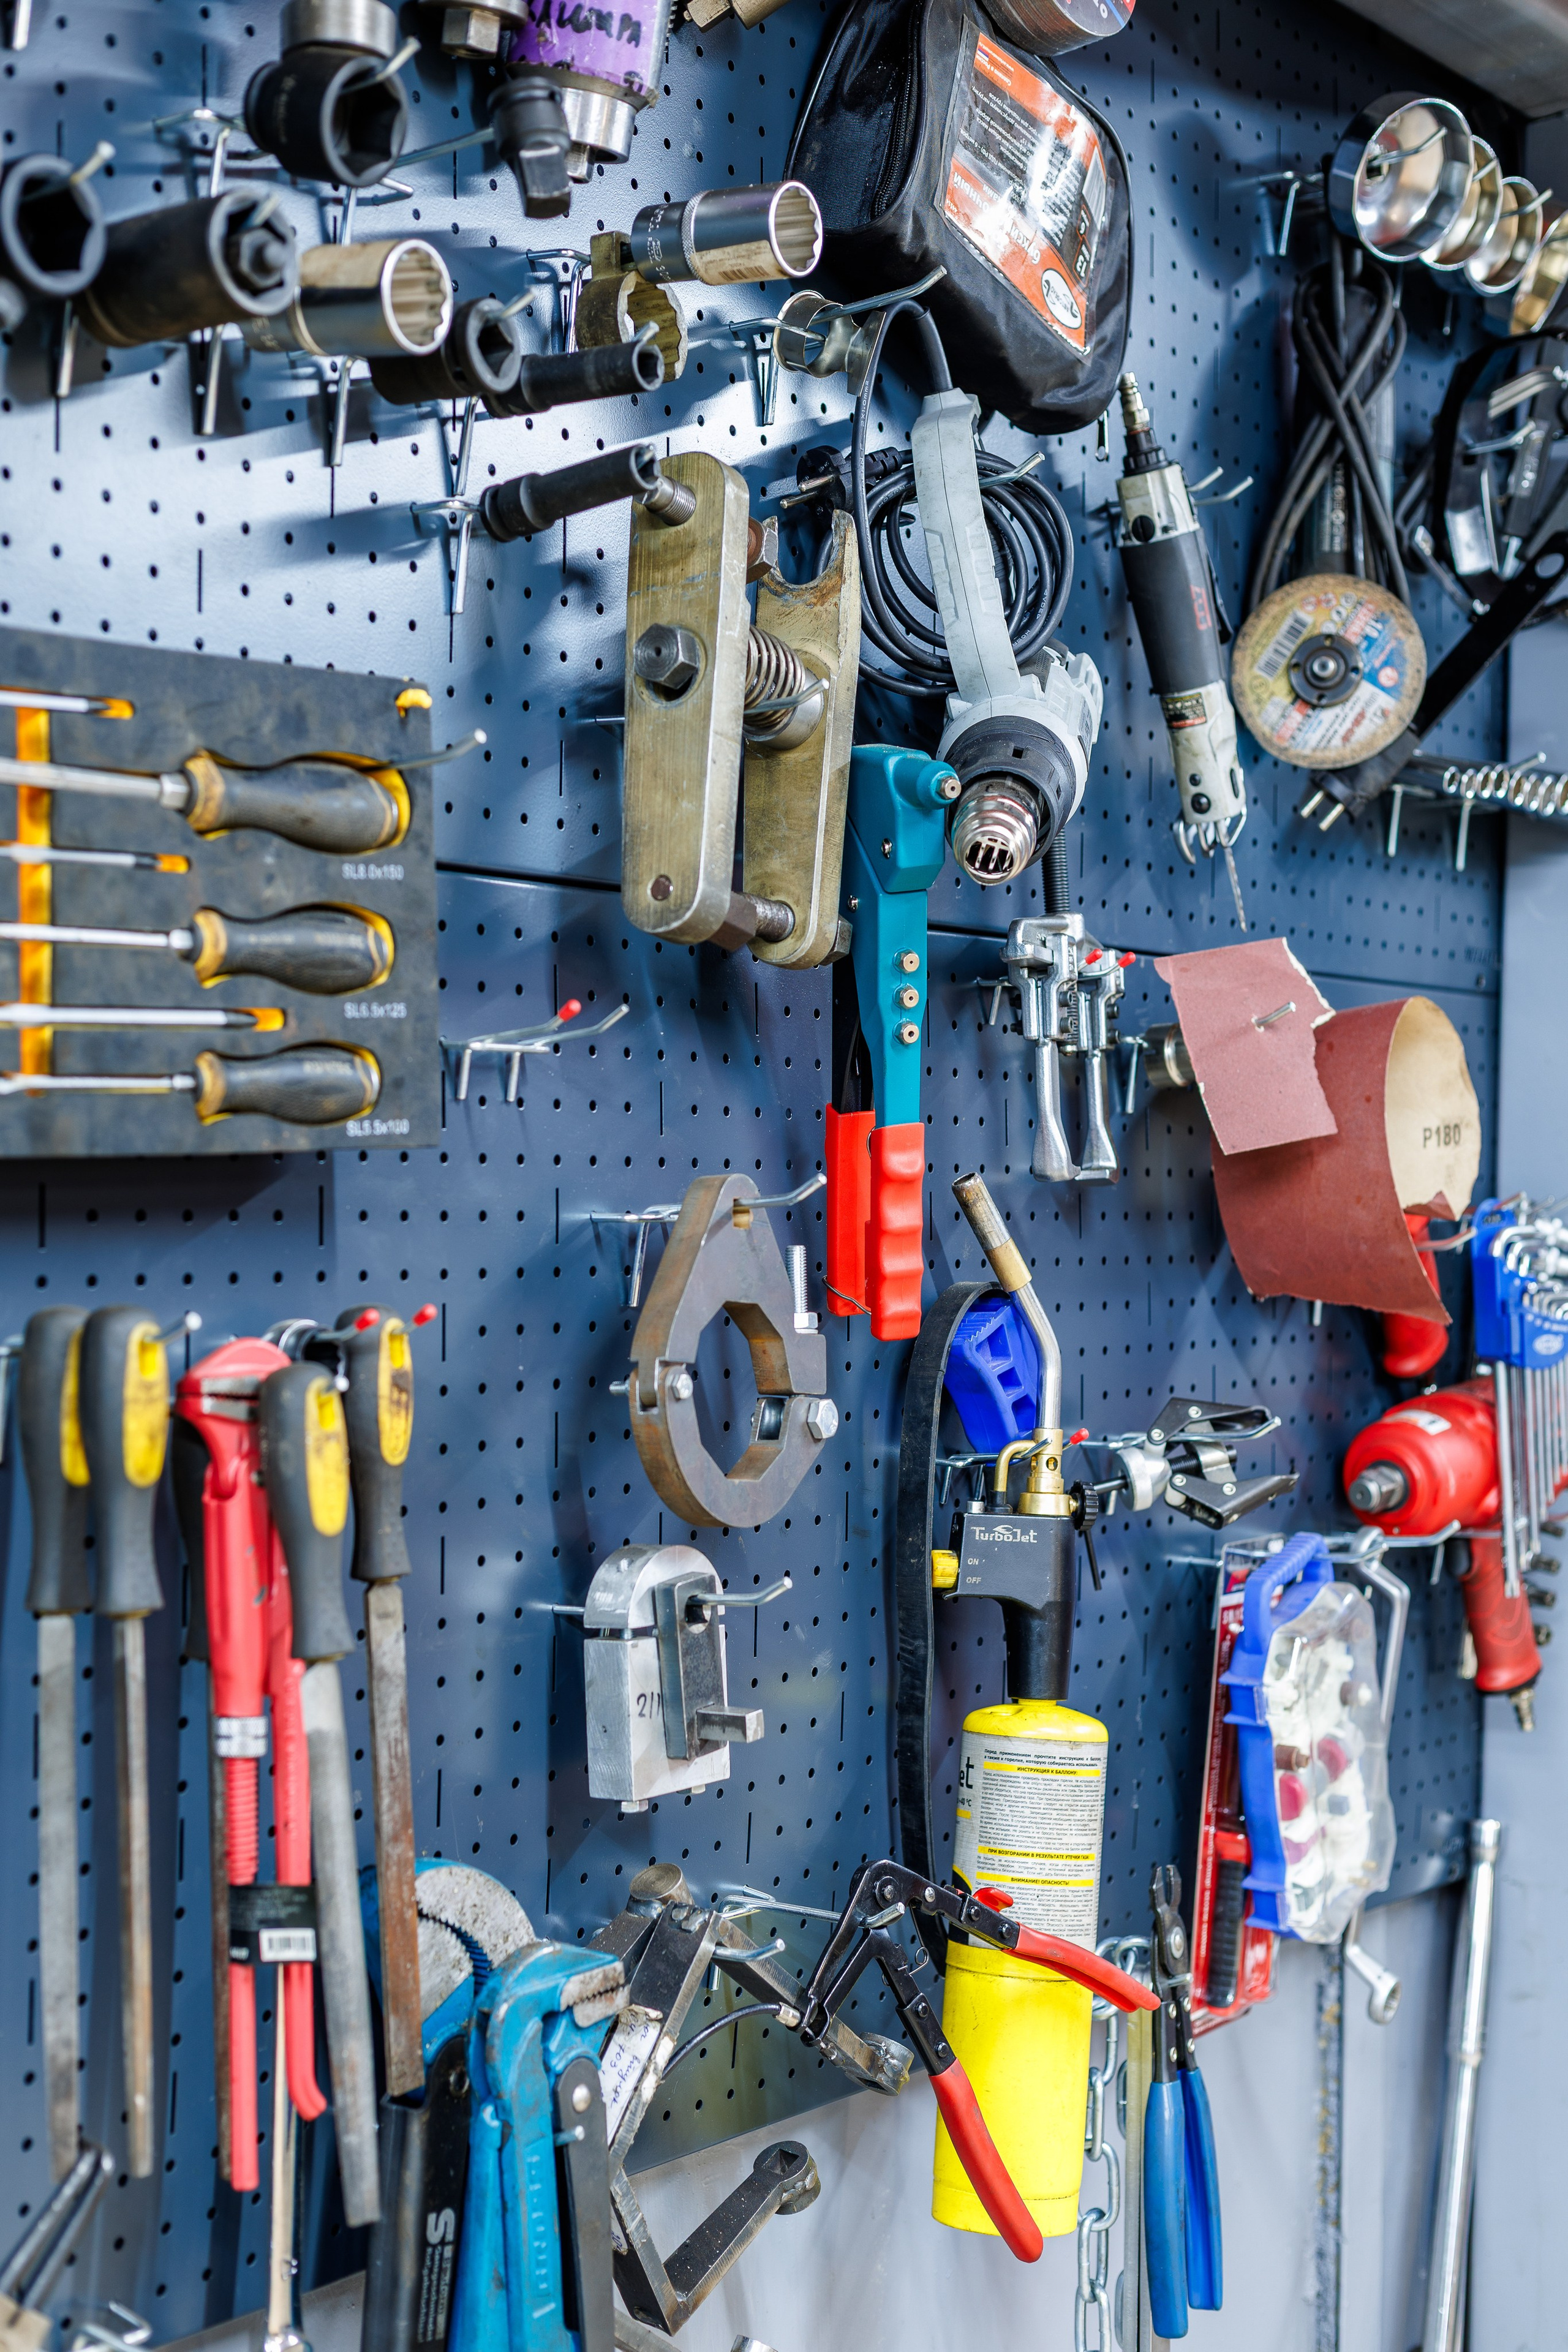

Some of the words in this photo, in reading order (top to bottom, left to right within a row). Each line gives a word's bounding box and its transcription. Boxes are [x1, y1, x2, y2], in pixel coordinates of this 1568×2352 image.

[975, 53, 990, 70] России
[993, 67, 1011, 87] Сделано
[989, 91, 1003, 106] грузов
[976, 106, 990, 121] дороге
[990, 100, 1014, 124] допустимую
[976, 116, 988, 130] масса
[1028, 124, 1037, 136] трос
[959, 127, 974, 143] метров.
[987, 126, 1001, 142] общая
[990, 118, 1027, 154] асфальтированной
[988, 153, 998, 165] ПДД
[1079, 219, 1085, 236] 6
[1076, 250, 1087, 279] 13
[1423, 1124, 1461, 1148] P180
[971, 1525, 1038, 1544] TurboJet
